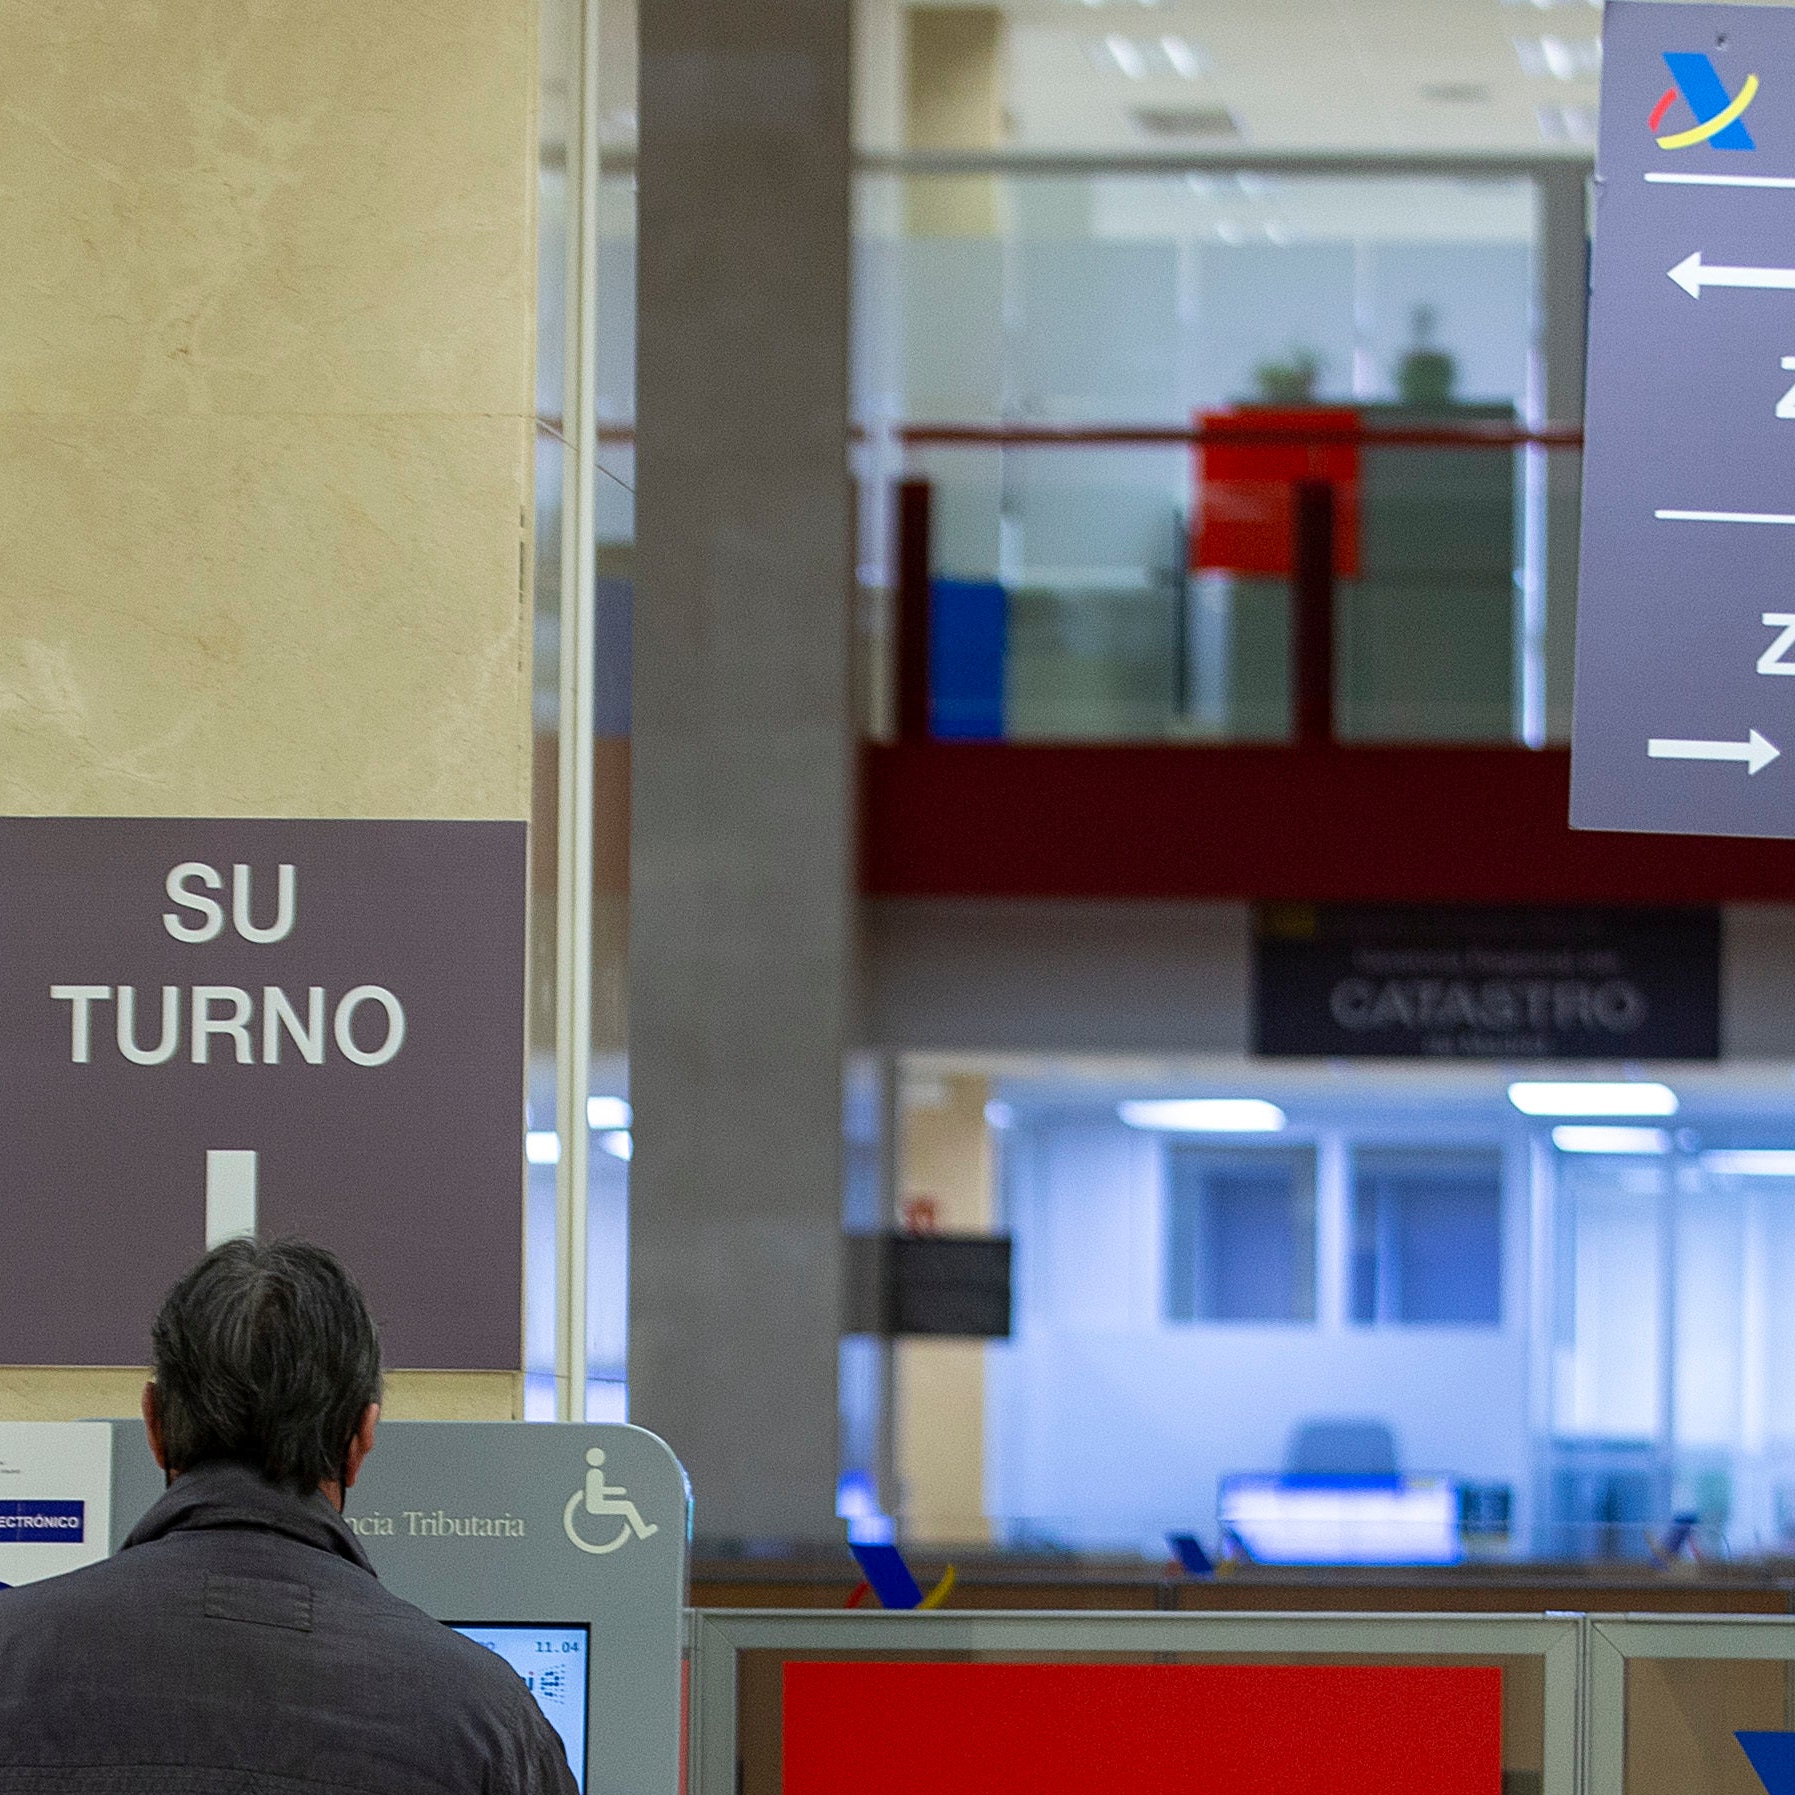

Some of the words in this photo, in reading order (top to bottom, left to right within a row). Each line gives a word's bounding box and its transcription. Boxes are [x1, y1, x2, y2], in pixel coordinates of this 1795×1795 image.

[162, 861, 296, 944] SU
[49, 984, 407, 1067] TURNO
[1329, 976, 1645, 1033] CATASTRO
[345, 1511, 395, 1536] ncia
[403, 1510, 525, 1537] Tributaria
[535, 1641, 580, 1653] 11.04
